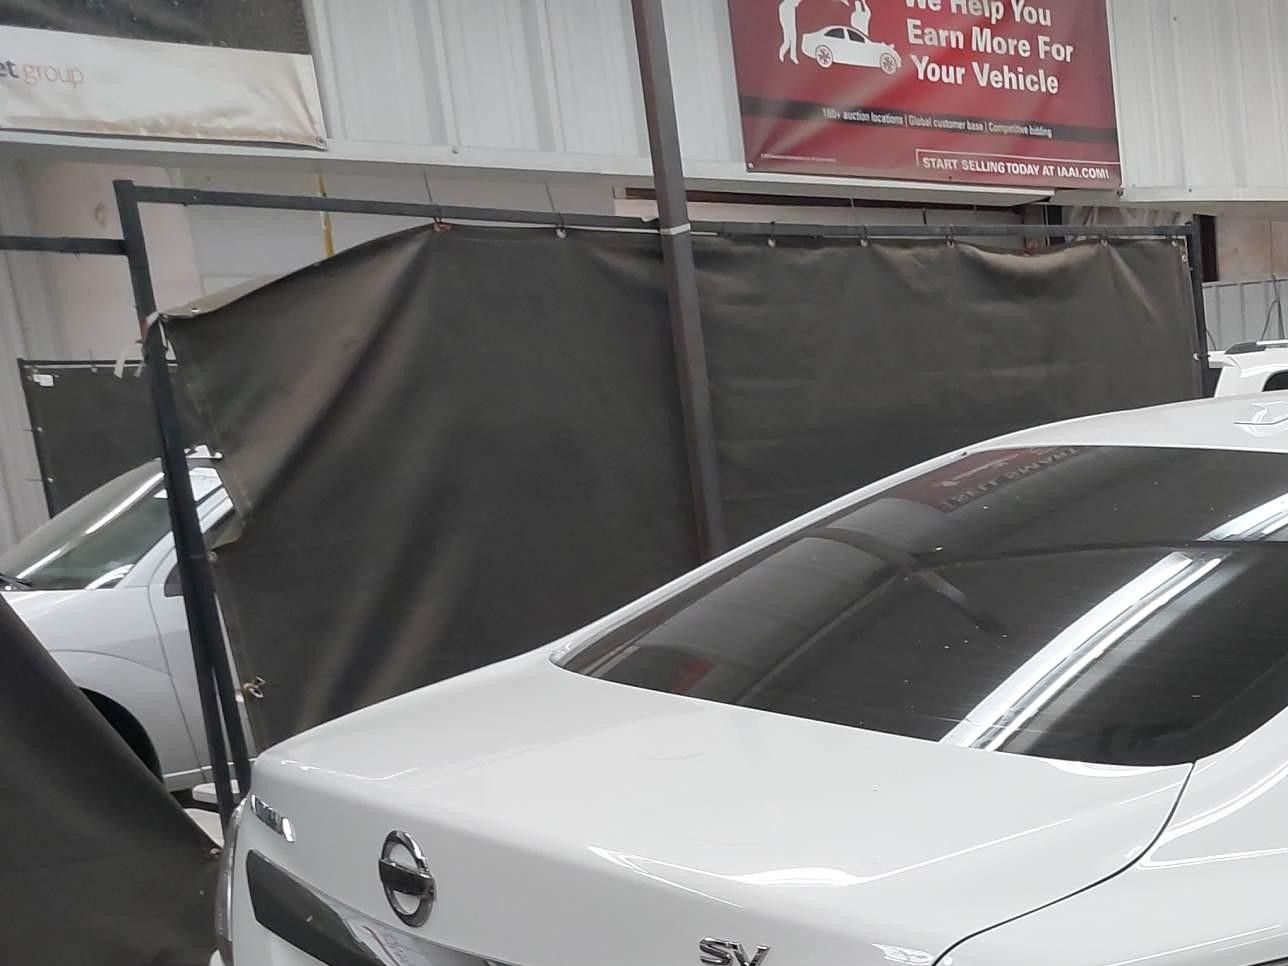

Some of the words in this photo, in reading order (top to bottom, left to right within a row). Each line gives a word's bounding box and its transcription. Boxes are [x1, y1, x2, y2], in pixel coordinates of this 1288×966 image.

[906, 0, 942, 11] e
[951, 0, 1004, 24] Help
[1011, 0, 1051, 26] You
[907, 18, 964, 49] Earn
[971, 26, 1031, 57] More
[1037, 35, 1073, 62] For
[23, 64, 85, 88] group
[910, 54, 966, 84] Your
[972, 61, 1059, 94] Vehicle
[842, 111, 870, 122] auction
[870, 112, 903, 125] locations
[909, 114, 932, 128] Global
[933, 119, 966, 130] customer
[966, 120, 984, 131] base
[988, 121, 1029, 135] Competitive
[1029, 125, 1052, 139] bidding
[922, 157, 958, 170] START
[961, 159, 1005, 174] SELLING
[1006, 162, 1039, 176] TODAY
[1042, 165, 1054, 177] AT
